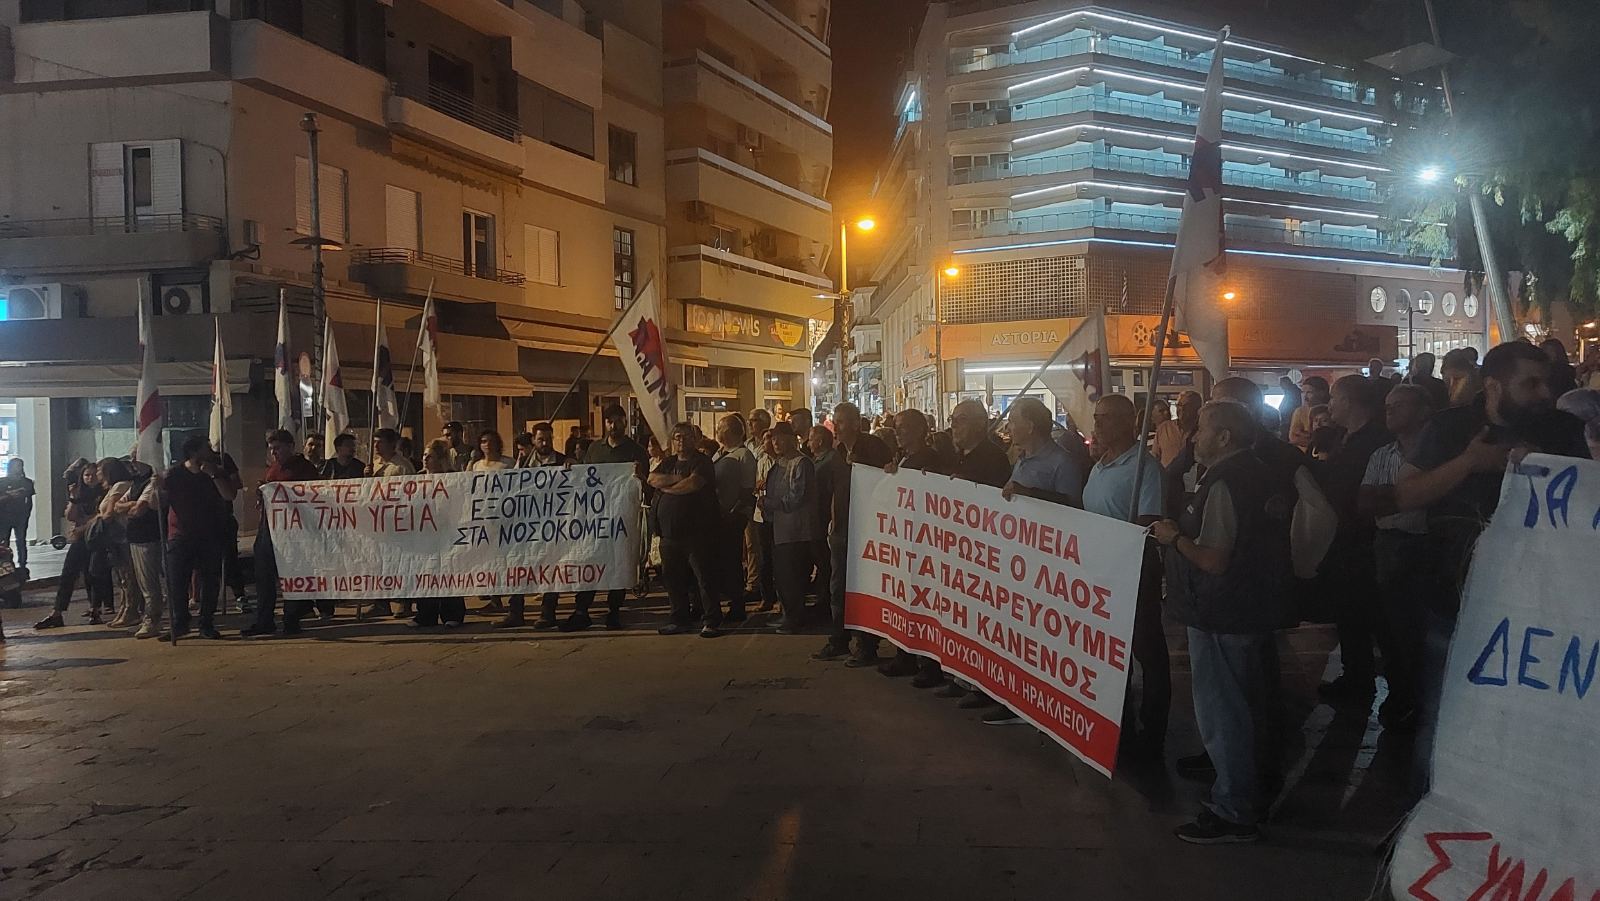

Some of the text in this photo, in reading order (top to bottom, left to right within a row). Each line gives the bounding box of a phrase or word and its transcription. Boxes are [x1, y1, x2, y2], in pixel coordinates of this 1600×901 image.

[991, 330, 1060, 345] ΑΣΤΟΡΙΑ
[370, 479, 450, 502] ΛΕΦΤΑ
[471, 466, 603, 494] ΓΙΑΤΡΟΥΣ &
[1516, 463, 1580, 530] ΤΑ
[271, 503, 438, 532] ΓΙΑ ΤΗΝ ΥΓΕΙΑ
[471, 489, 606, 522] ΕΞΟΠΛΗΣΜΟ
[896, 486, 1081, 565] ΤΑ ΝΟΣΟΚΟΜΕΙΑ
[453, 516, 628, 549] ΣΤΑ ΝΟΣΟΚΟΜΕΙΑ
[334, 574, 403, 592] ΙΔΙΩΤΙΚΩΝ
[415, 571, 496, 590] ΥΠΑΛΛΗΛΩΝ
[506, 564, 606, 587] ΗΡΑΚΛΕΙΟΥ
[876, 512, 1112, 620] ΤΑ ΠΛΗΡΩΣΕ Ο ΛΑΟΣ
[861, 540, 1127, 673] ΔΕΝ ΤΑ ΠΑΖΑΡΕΥΟΥΜΕ
[881, 573, 1097, 701] ΓΙΑ ΧΑΡΗ ΚΑΝΕΝΟΣ
[1467, 616, 1600, 700] ΔΕΝ
[881, 607, 906, 638] ΕΝΩΣΗ
[986, 657, 1006, 688] ΙΚΑ
[1008, 673, 1019, 696] Ν.
[1022, 682, 1096, 742] ΗΡΑΚΛΕΙΟΥ
